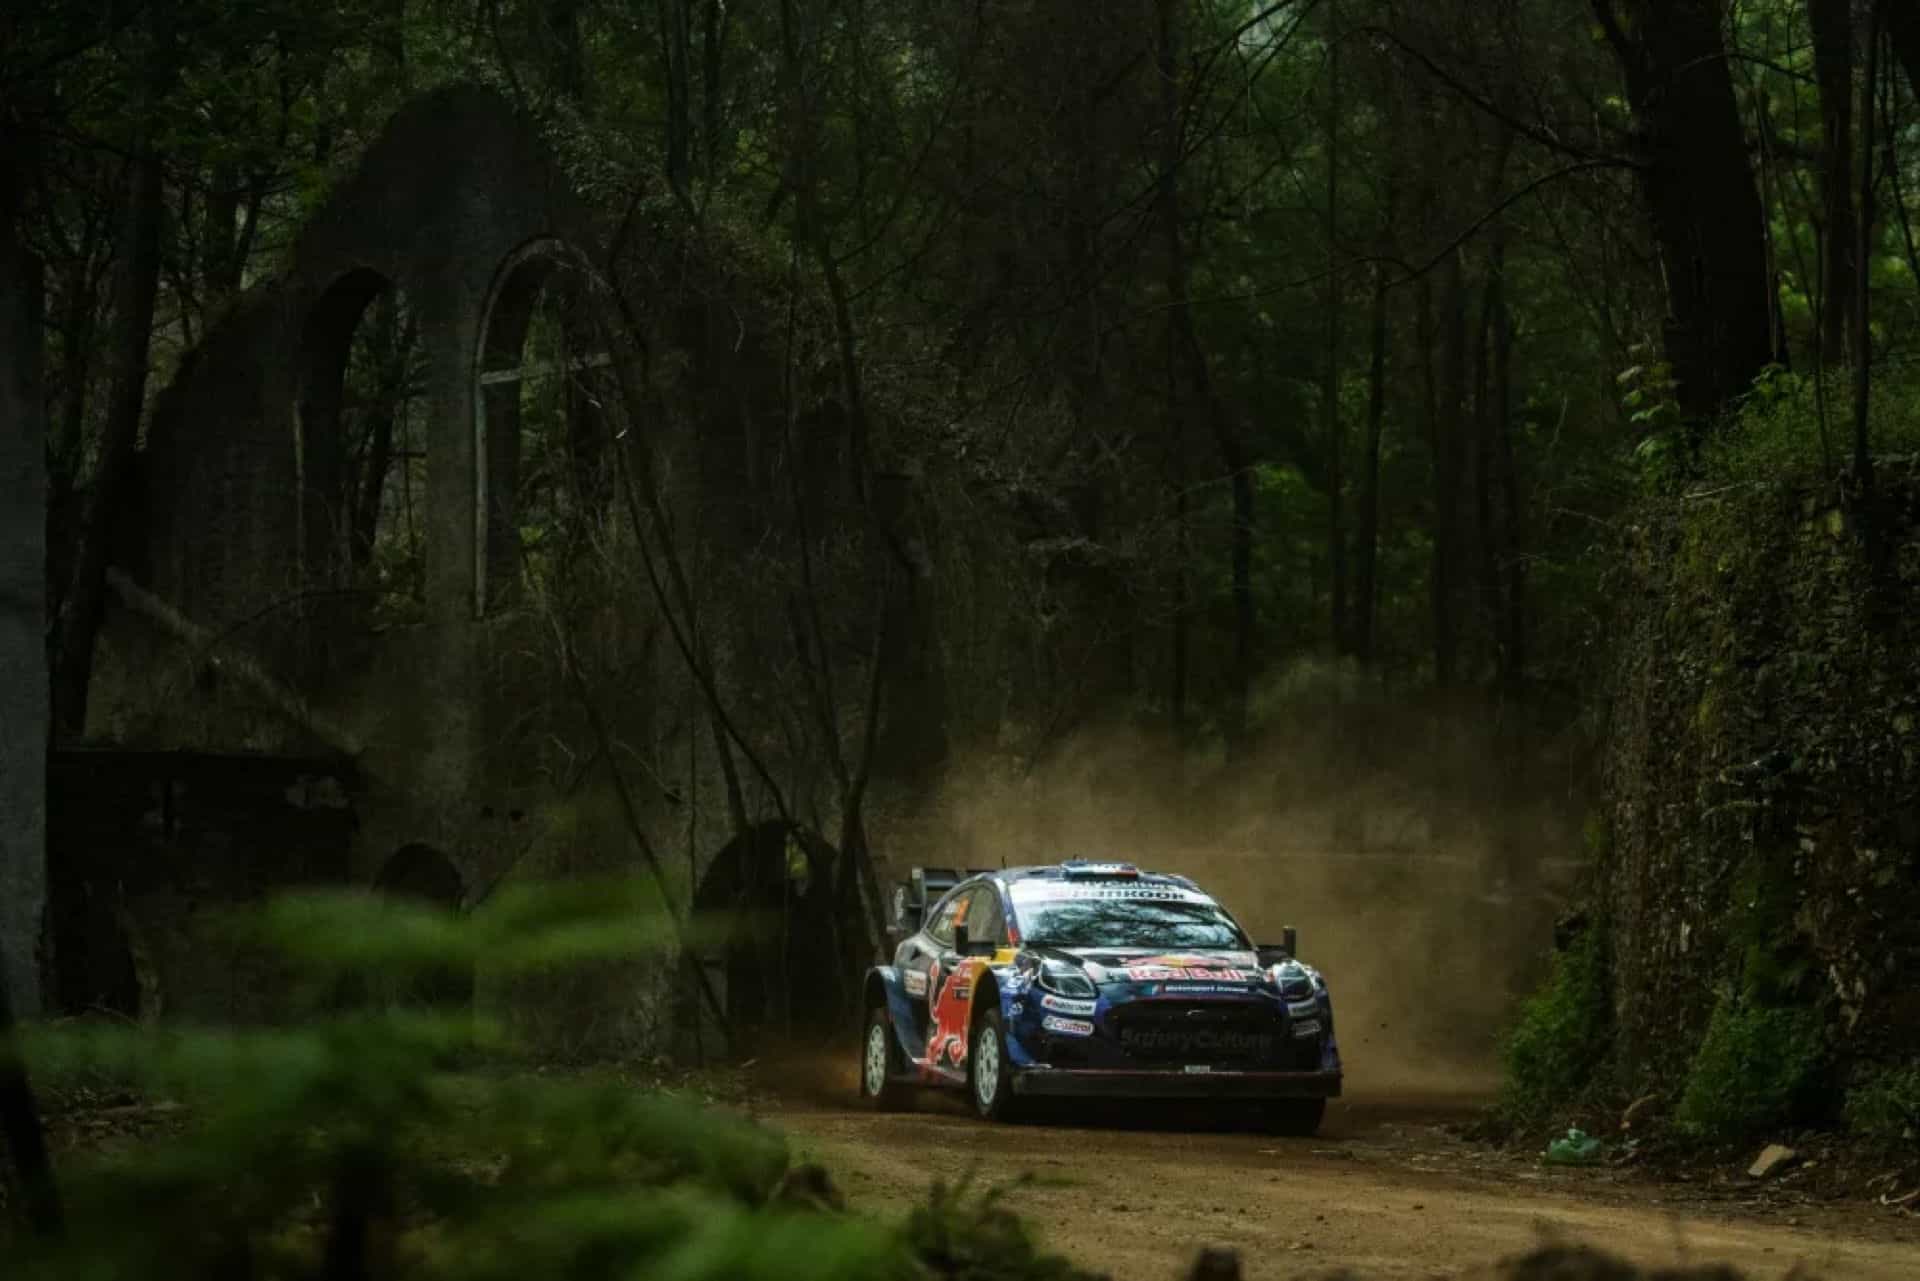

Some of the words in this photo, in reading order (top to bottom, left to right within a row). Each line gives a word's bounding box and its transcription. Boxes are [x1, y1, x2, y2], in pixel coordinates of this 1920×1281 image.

[1128, 967, 1185, 981] Red
[1187, 967, 1248, 981] Bull
[1055, 1020, 1090, 1032] Castrol
